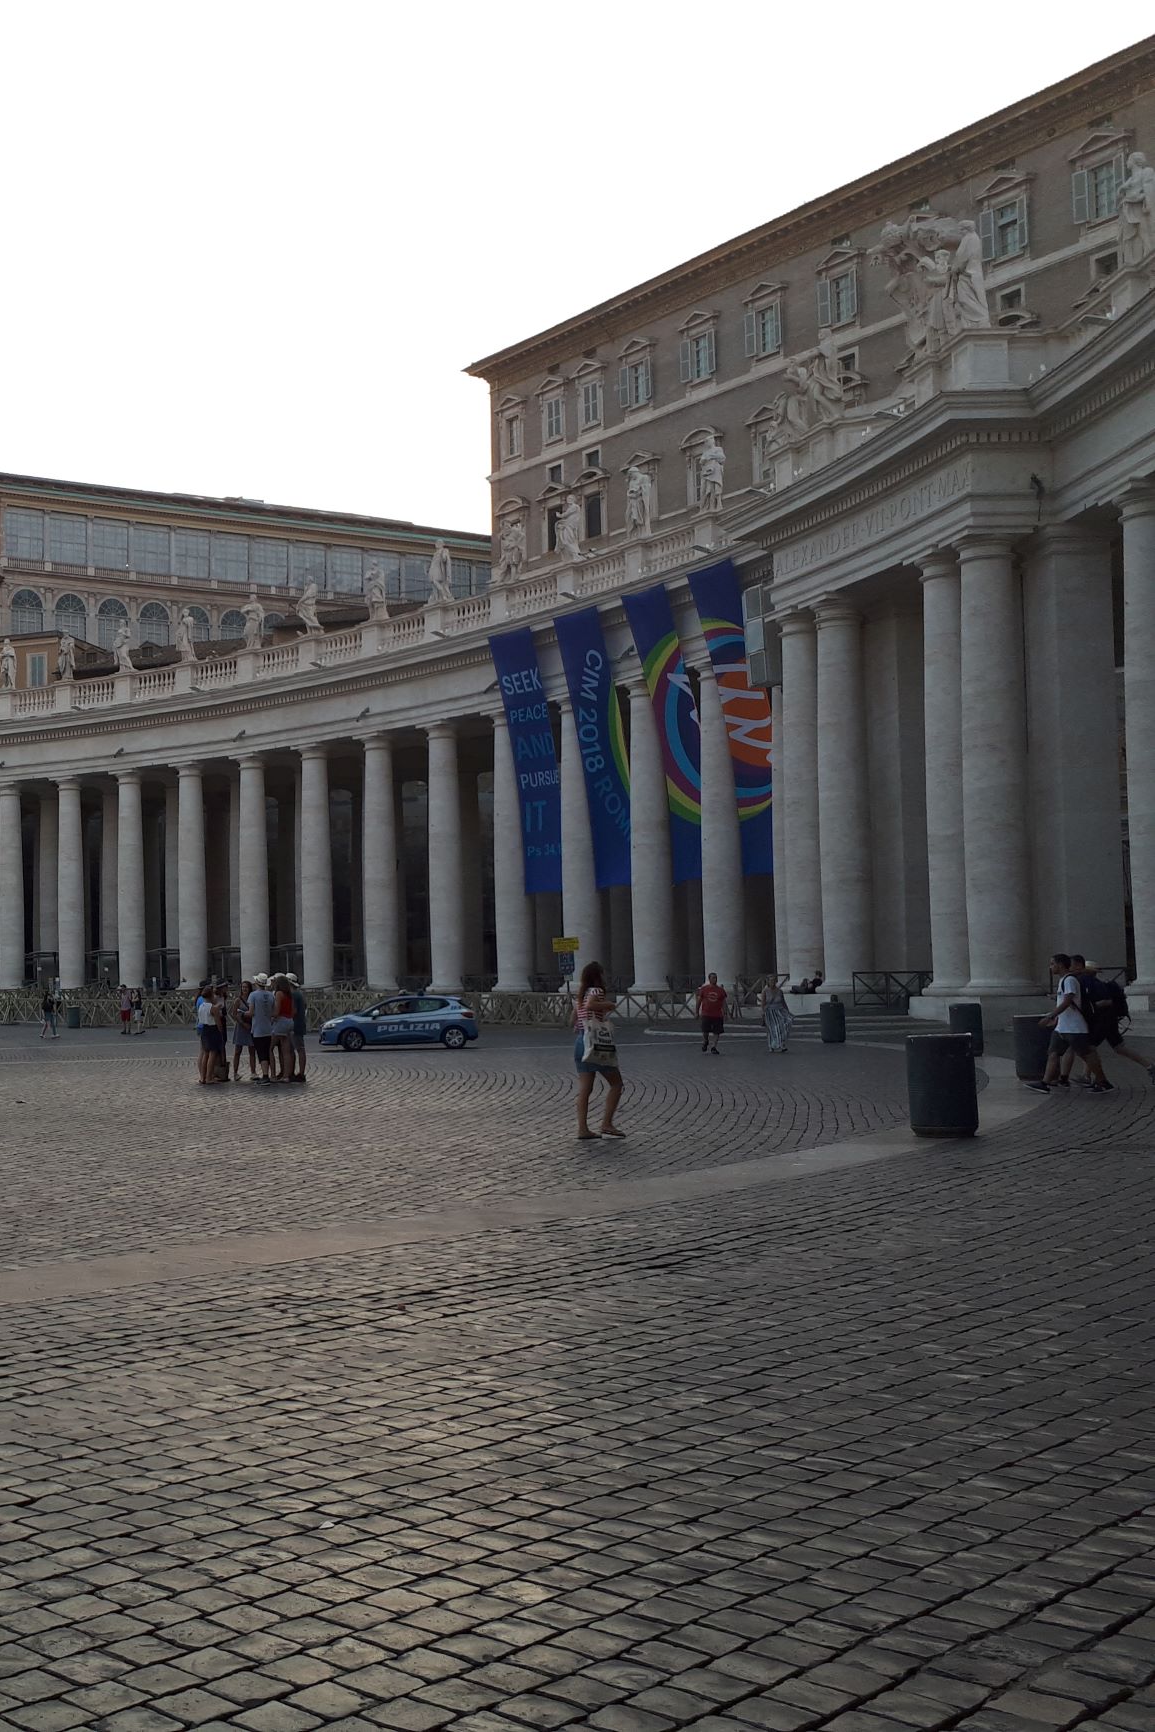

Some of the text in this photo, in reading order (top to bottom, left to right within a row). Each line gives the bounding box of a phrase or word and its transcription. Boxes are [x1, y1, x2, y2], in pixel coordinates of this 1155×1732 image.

[501, 666, 543, 695] SEEK
[509, 702, 548, 724] PEACE
[516, 731, 555, 761] AND
[578, 648, 631, 840] CIM 2018 ROM
[519, 769, 559, 790] PURSUE
[525, 799, 547, 832] IT
[377, 1022, 441, 1033] POLIZIA
